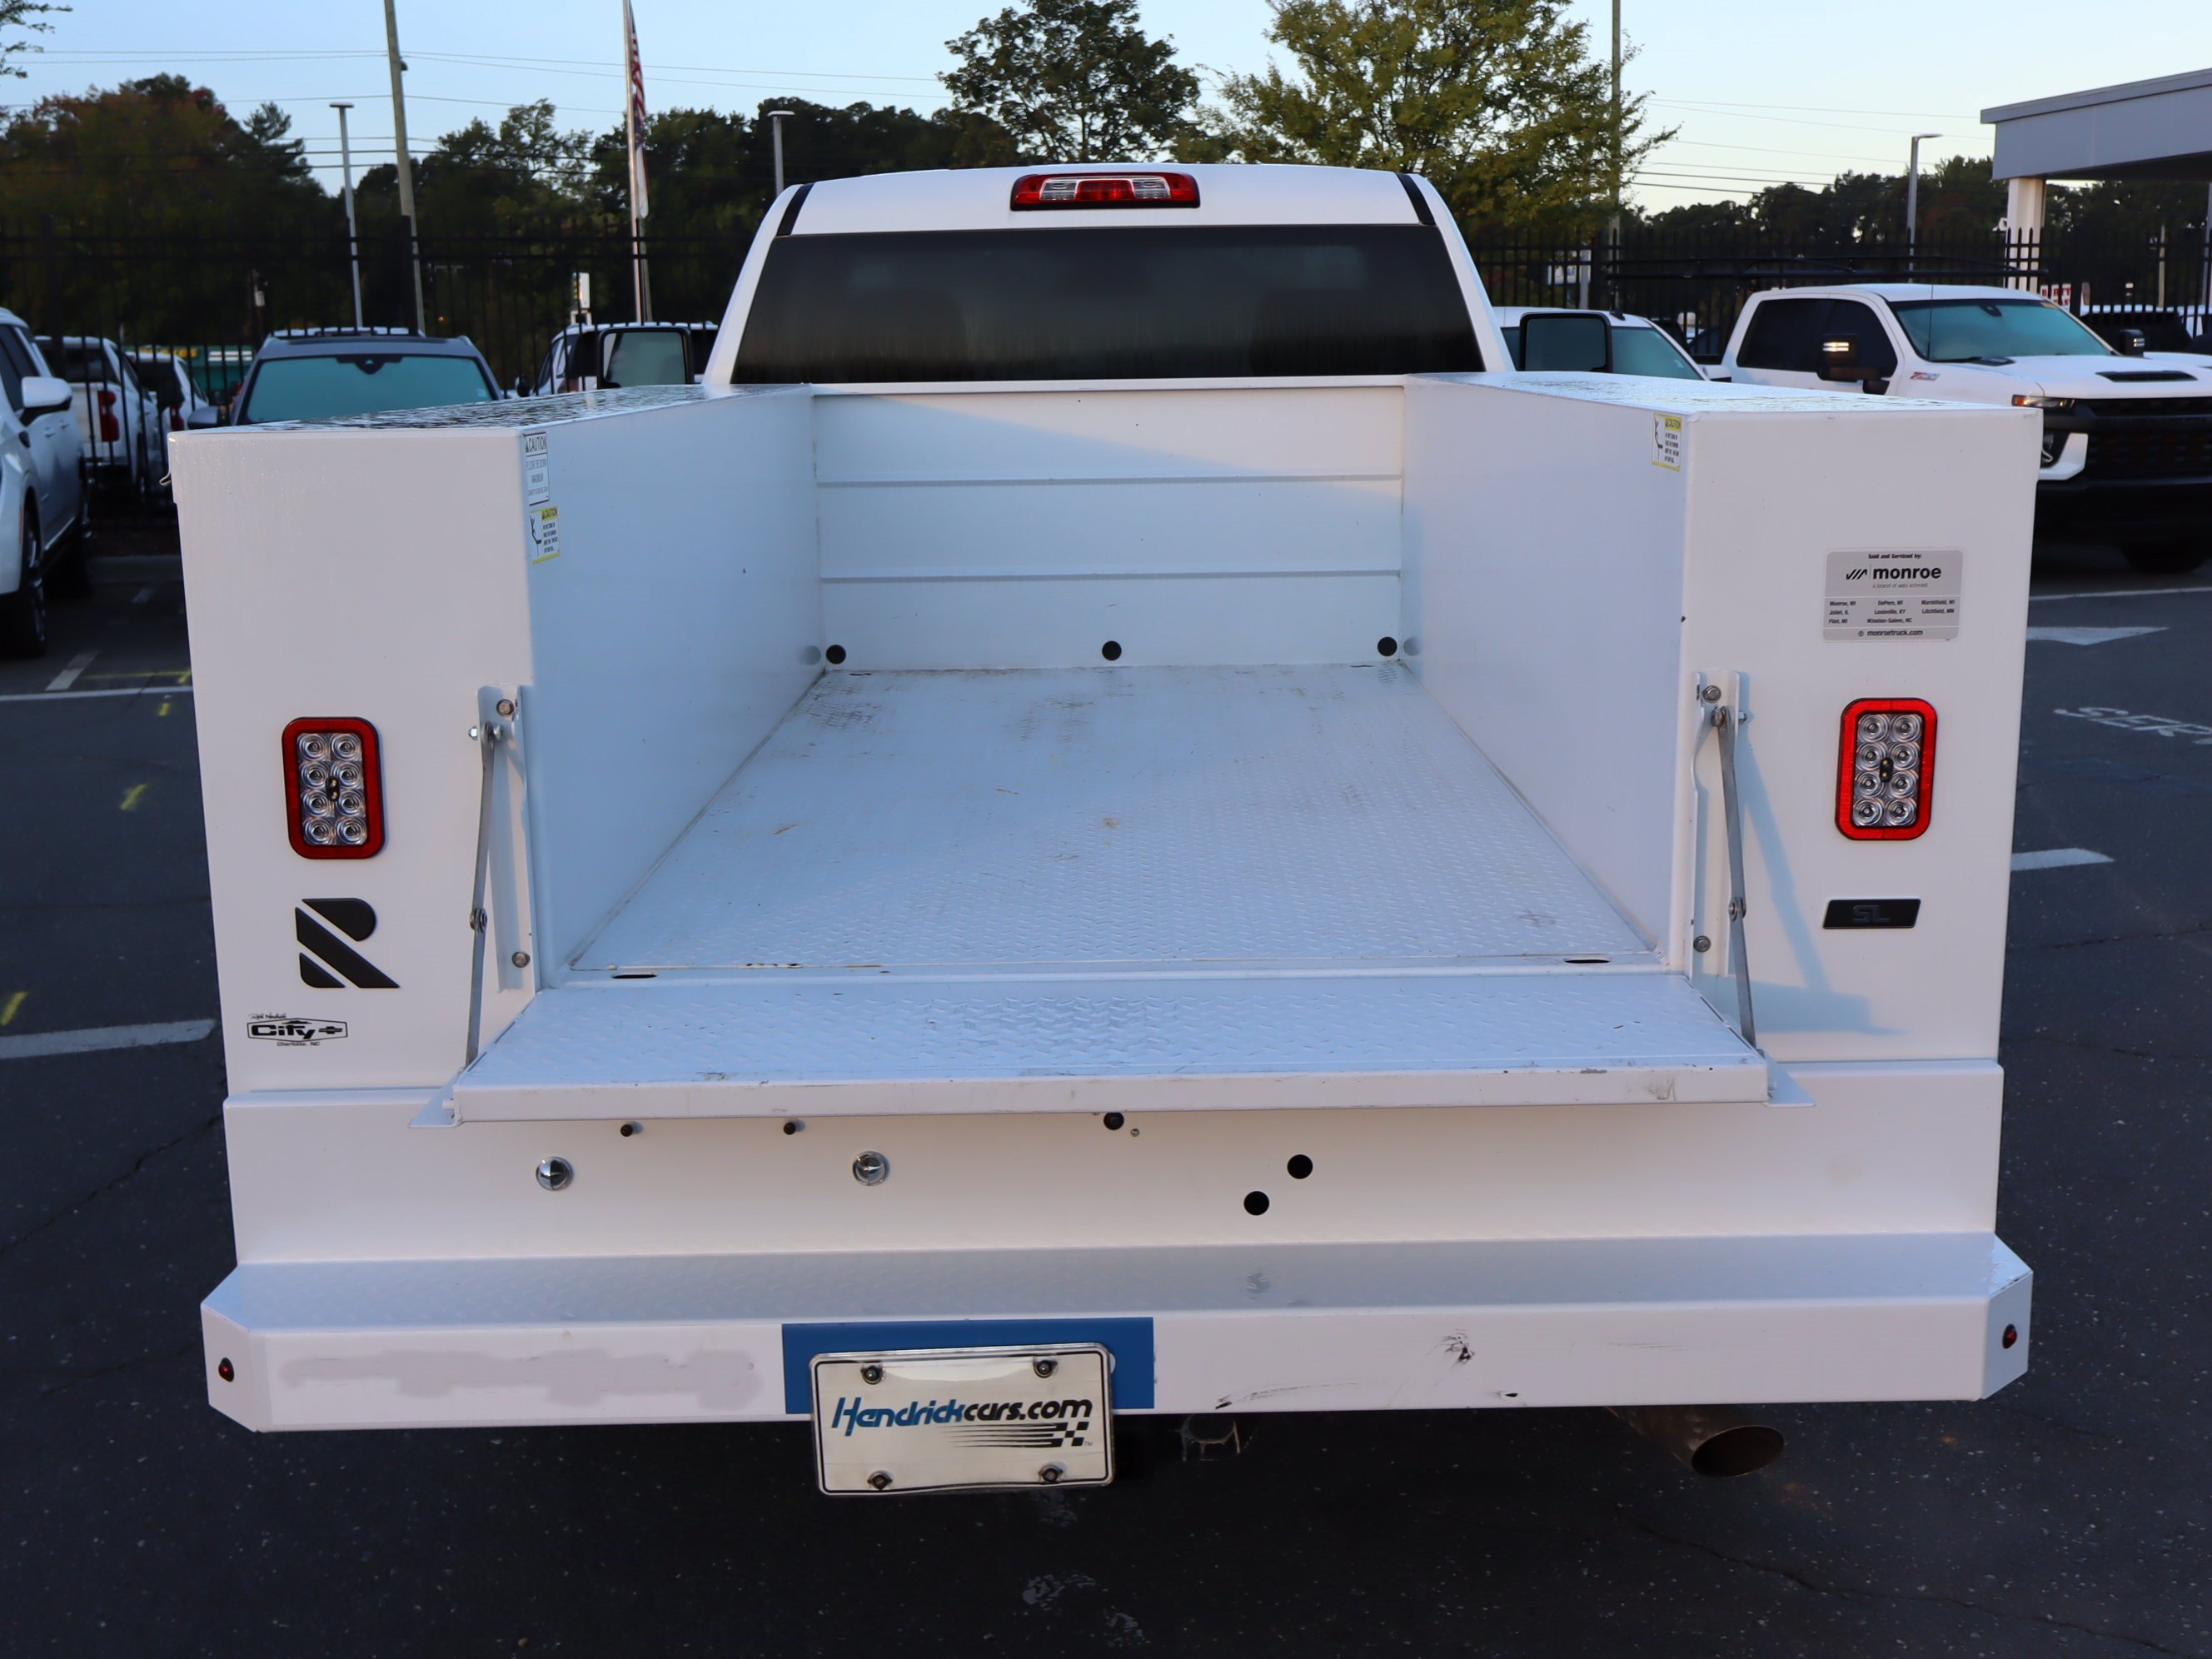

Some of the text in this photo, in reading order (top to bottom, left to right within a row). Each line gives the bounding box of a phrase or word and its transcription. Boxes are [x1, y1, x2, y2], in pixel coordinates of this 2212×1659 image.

[528, 436, 547, 452] CAUTION
[1873, 567, 1942, 580] monroe
[1852, 904, 1891, 924] SL
[252, 1024, 316, 1039] City
[831, 1397, 1093, 1437] Hendrickcars.com
